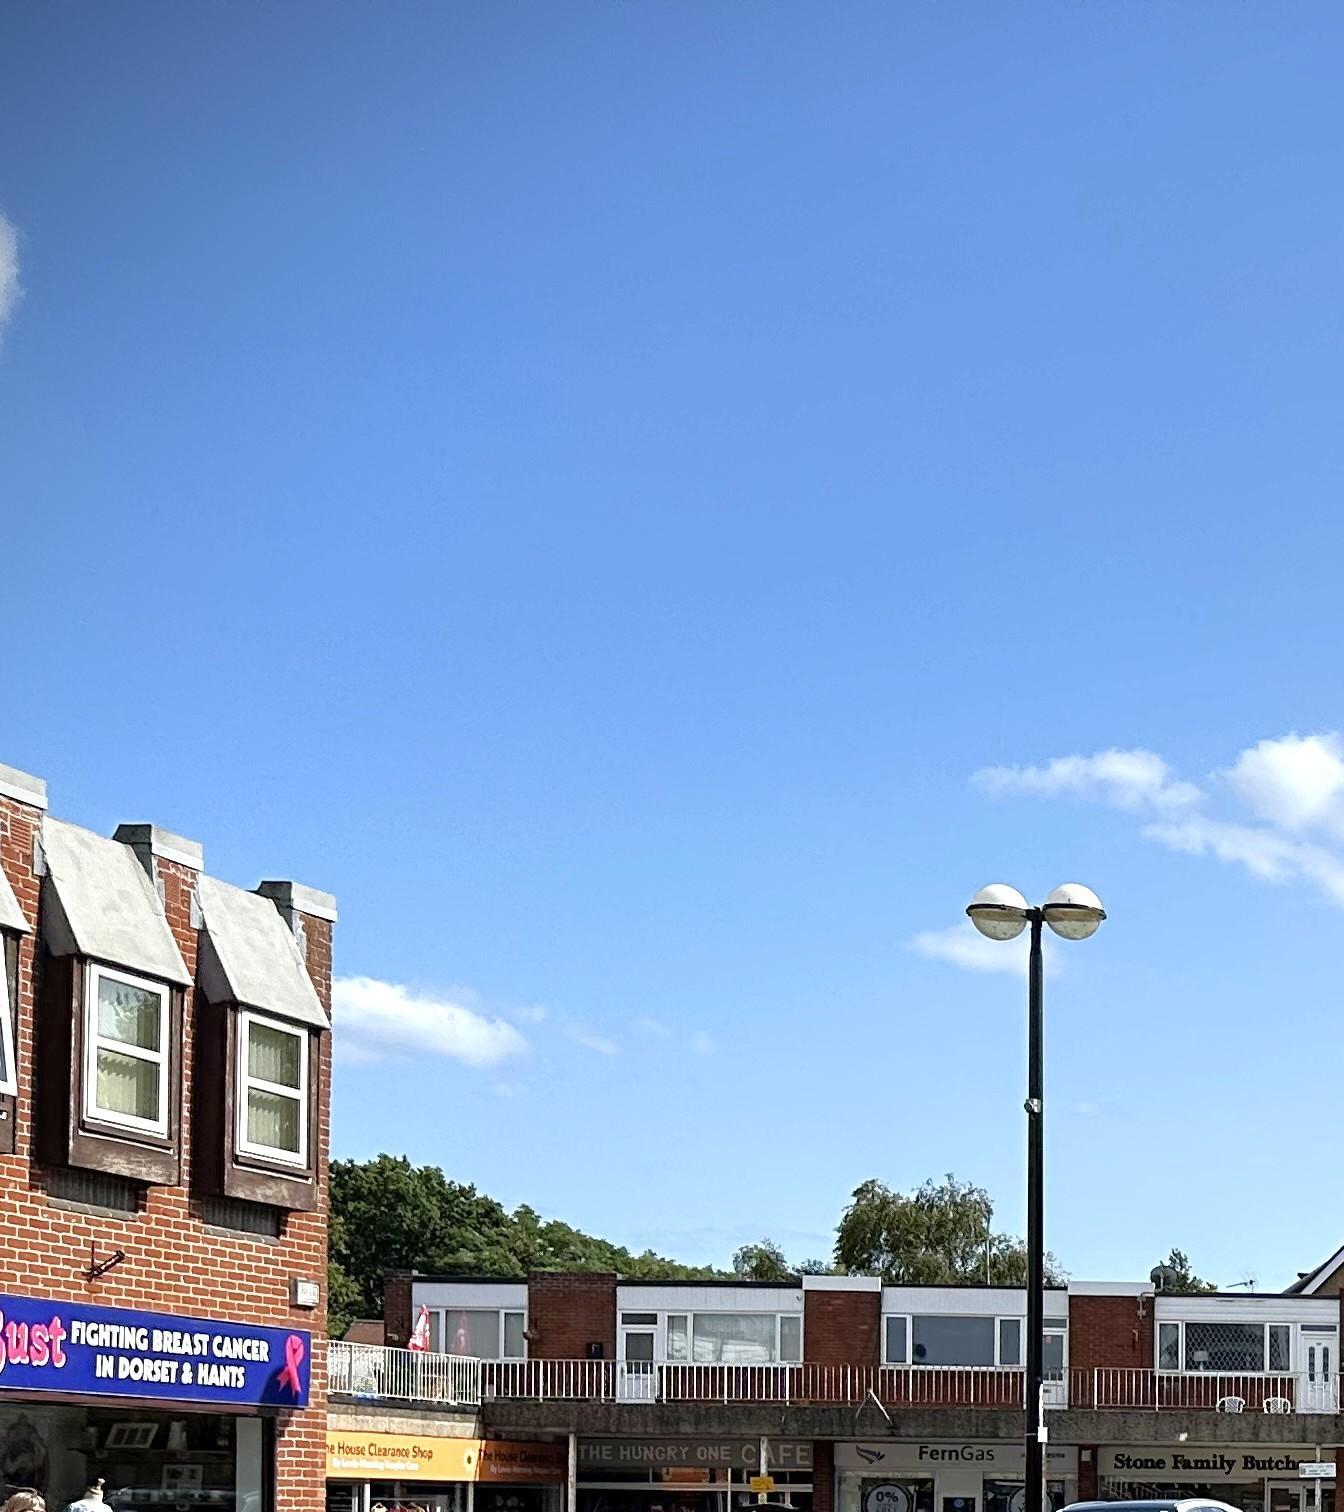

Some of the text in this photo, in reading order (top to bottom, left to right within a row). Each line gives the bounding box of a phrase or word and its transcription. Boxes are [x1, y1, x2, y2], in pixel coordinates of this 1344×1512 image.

[0, 1307, 66, 1375] ust
[71, 1321, 270, 1363] FIGHTING BREAST CANCER
[96, 1355, 246, 1389] IN DORSET & HANTS
[338, 1442, 365, 1457] House
[368, 1443, 410, 1459] Clearance
[413, 1444, 433, 1461] Shop
[579, 1445, 613, 1460] THE
[620, 1445, 689, 1461] HUNGRY
[696, 1445, 731, 1461] ONE
[918, 1446, 995, 1461] FernGas
[1114, 1453, 1165, 1470] Stone
[1172, 1454, 1237, 1474] Family
[876, 1491, 898, 1503] 0%
